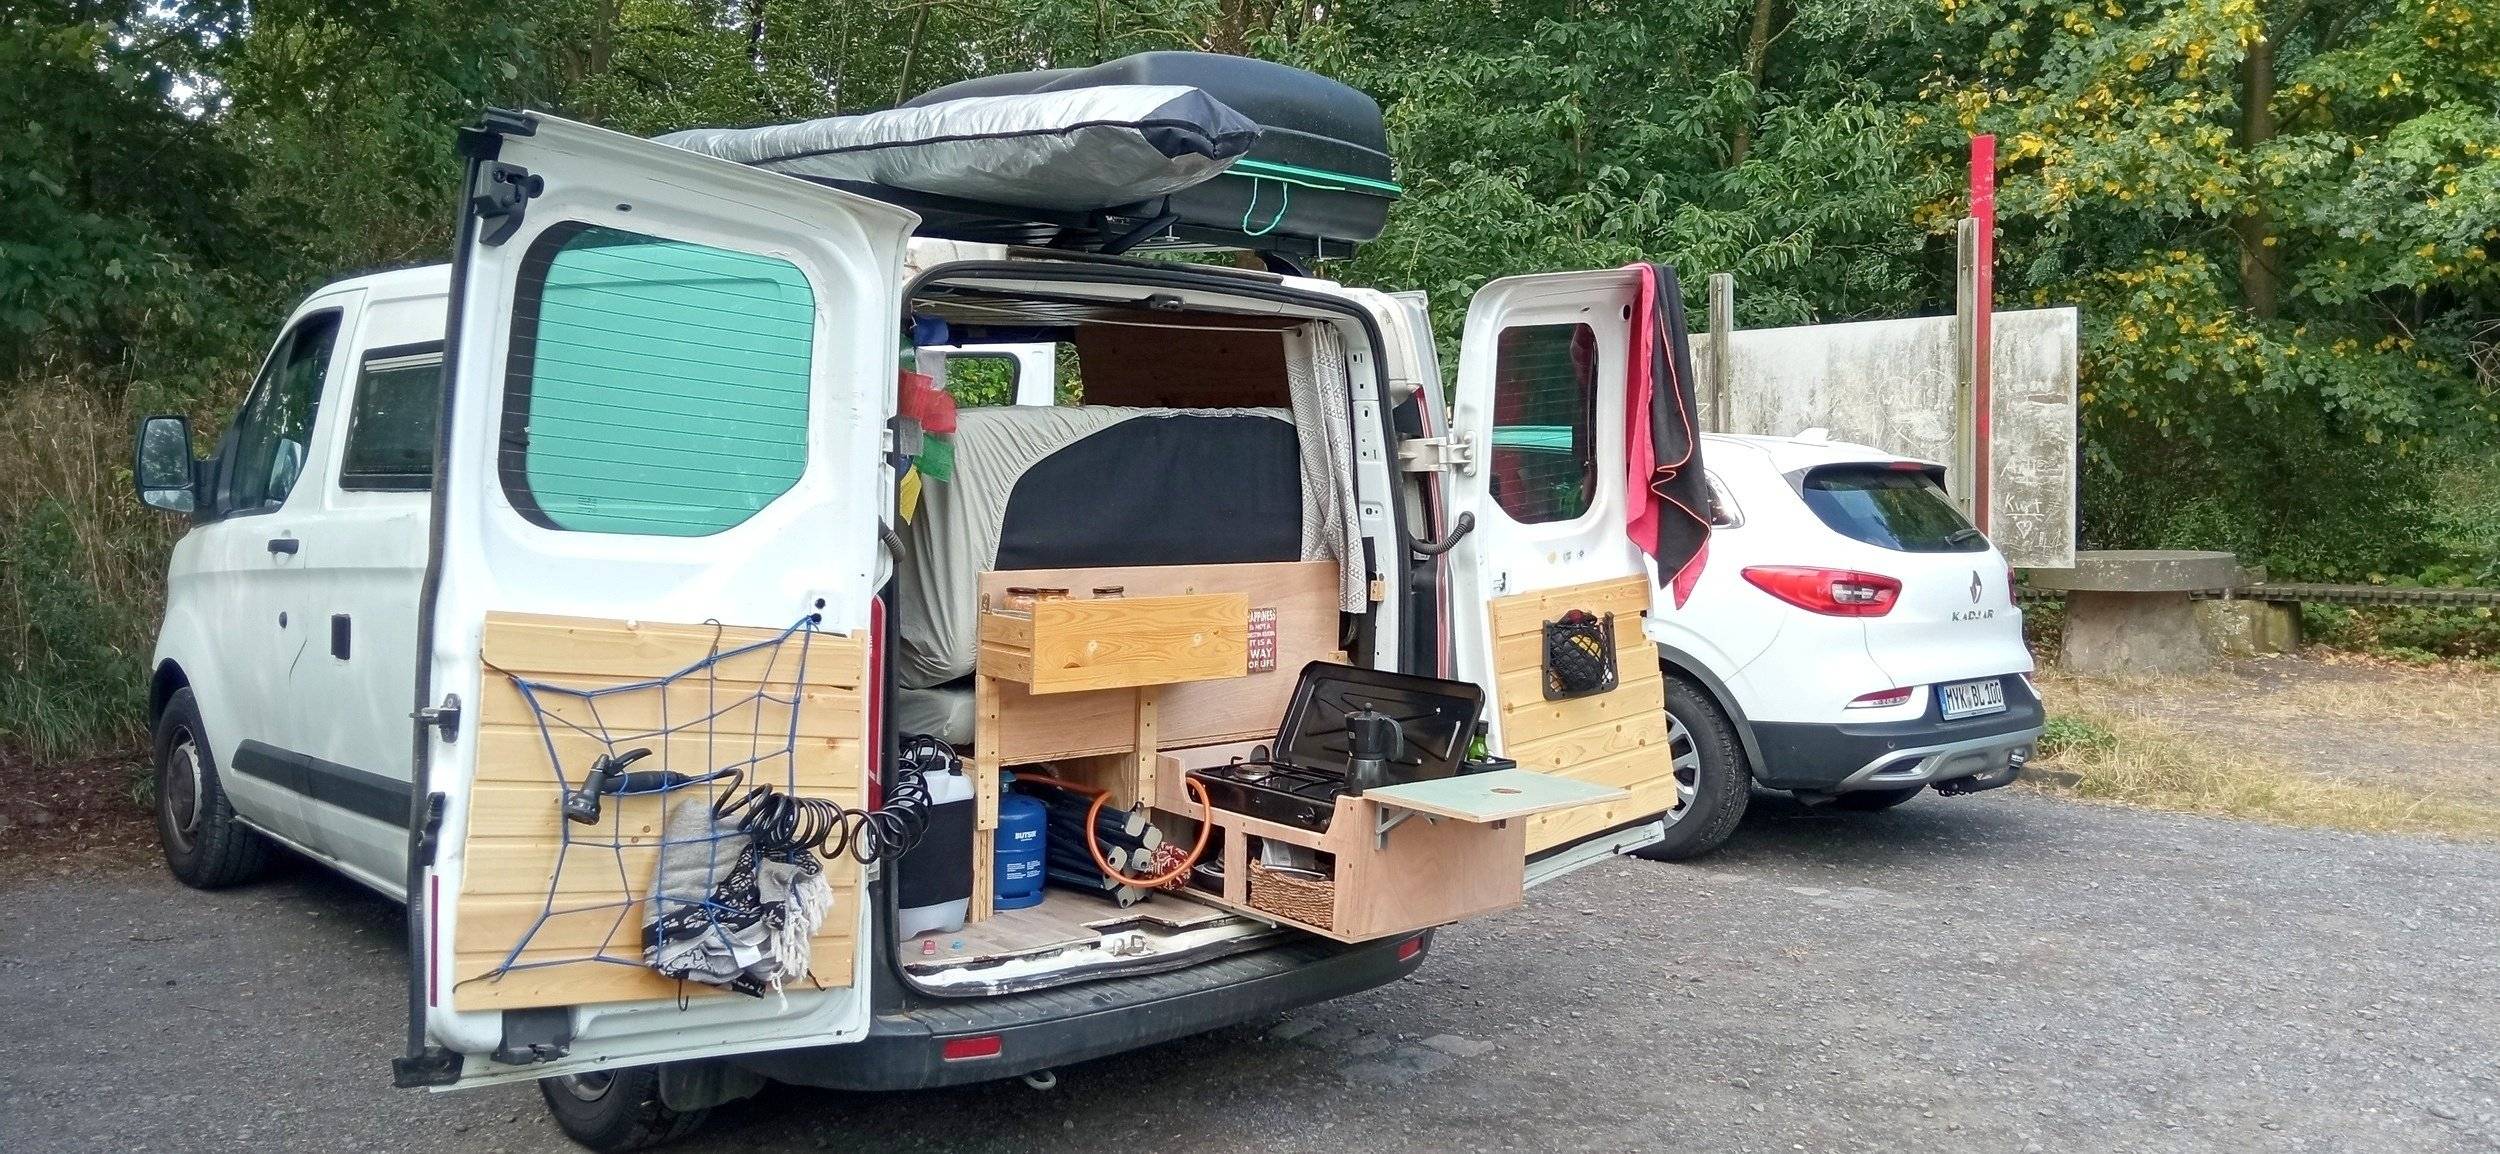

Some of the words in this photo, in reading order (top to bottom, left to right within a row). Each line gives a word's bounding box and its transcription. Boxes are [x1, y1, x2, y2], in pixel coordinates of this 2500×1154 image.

[1951, 609, 1994, 621] KADJAR
[1250, 648, 1272, 659] WAY
[1945, 687, 1968, 711] MYK
[1970, 684, 1985, 706] BL
